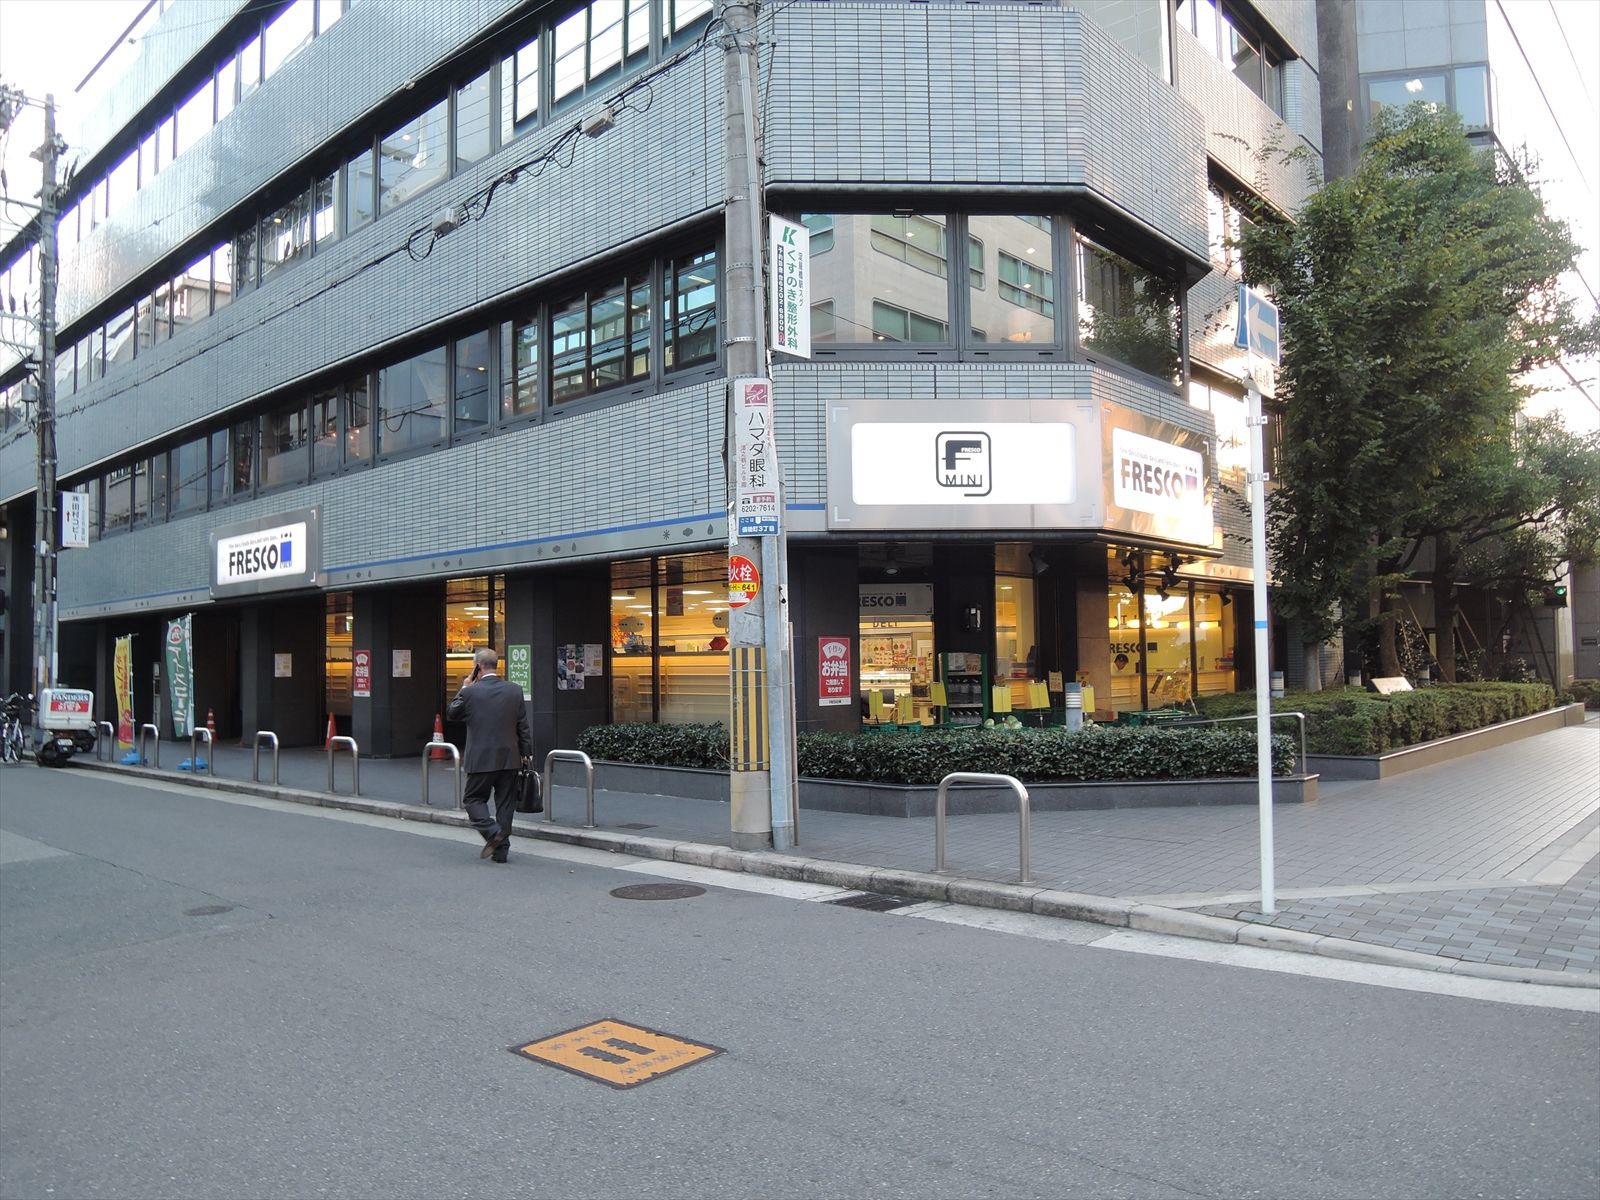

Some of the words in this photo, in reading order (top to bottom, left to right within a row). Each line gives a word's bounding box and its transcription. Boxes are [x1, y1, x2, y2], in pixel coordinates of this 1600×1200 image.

[782, 225, 797, 246] K
[786, 250, 799, 349] くすのき整形外科
[748, 412, 767, 488] ハマダ眼科
[945, 474, 983, 487] MINI
[1121, 457, 1184, 500] FRESCO
[229, 544, 279, 577] FRESCO
[730, 564, 753, 581] 火栓
[510, 662, 529, 670] イートイン
[511, 671, 529, 679] スペース
[822, 660, 848, 677] お弁当
